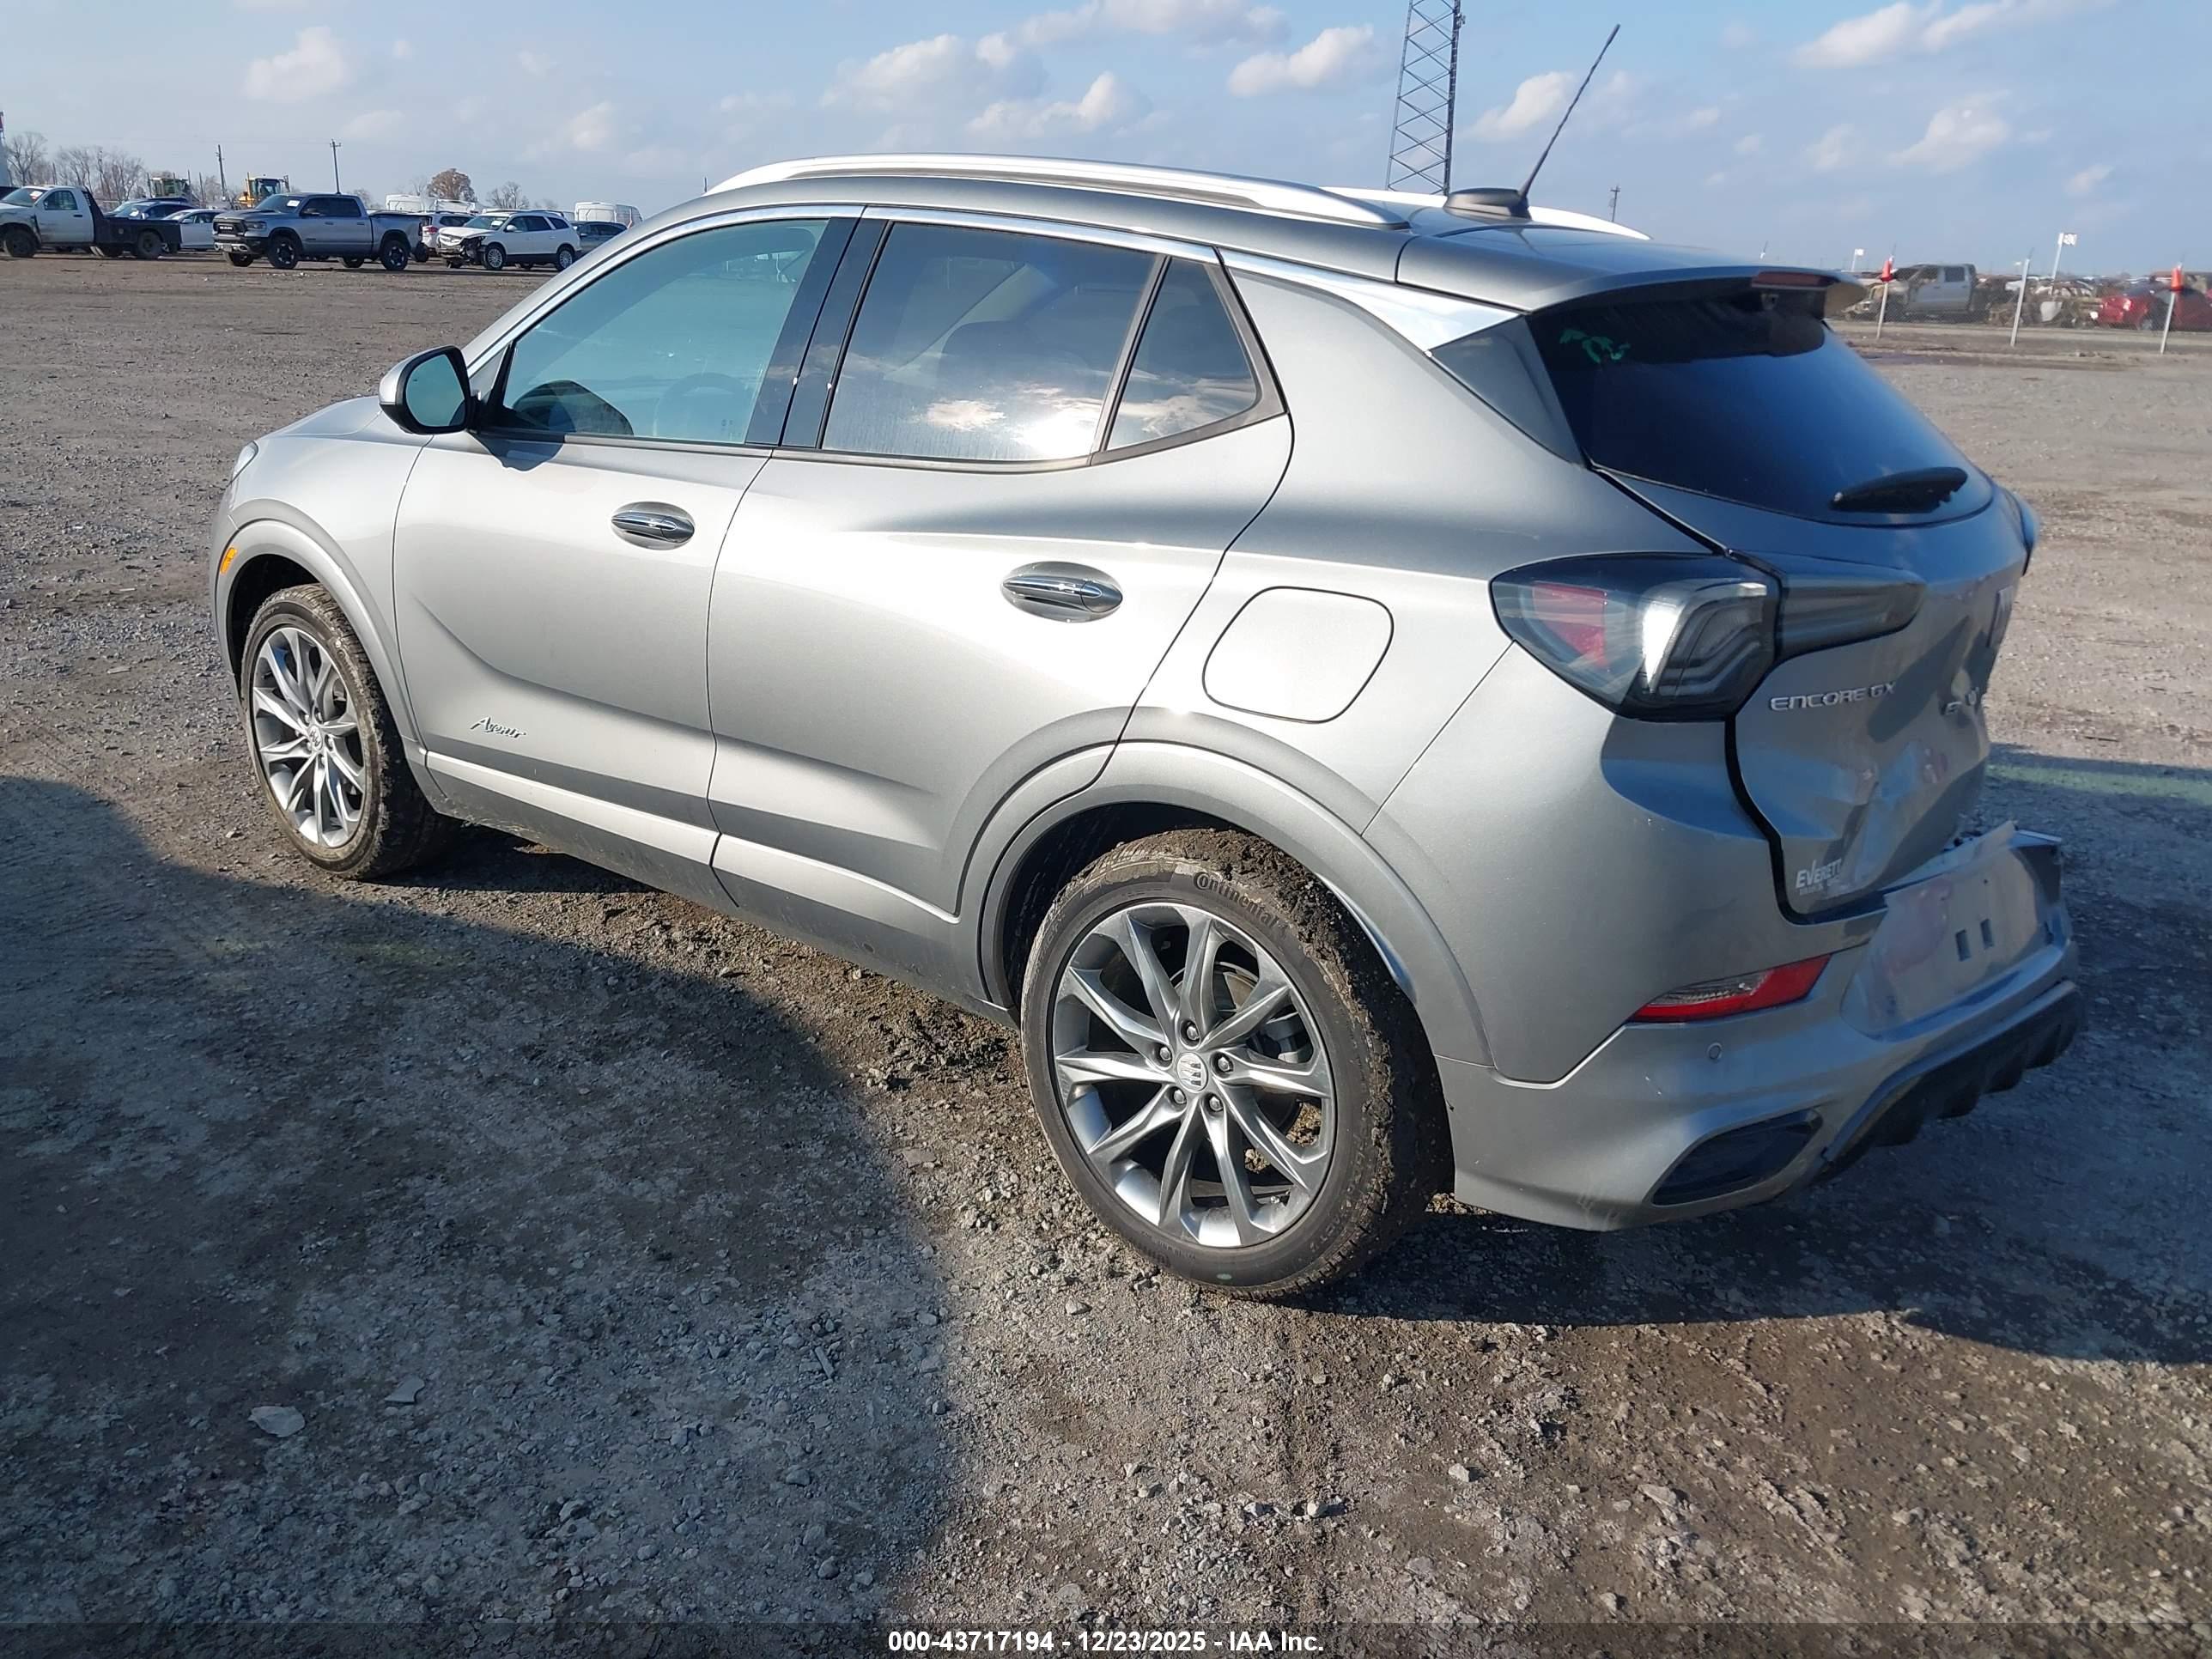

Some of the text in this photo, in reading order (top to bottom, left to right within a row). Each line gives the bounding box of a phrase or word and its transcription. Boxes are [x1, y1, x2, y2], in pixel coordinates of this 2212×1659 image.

[1770, 681, 1896, 711] ENCORE GX
[1192, 871, 1279, 928] Continental
